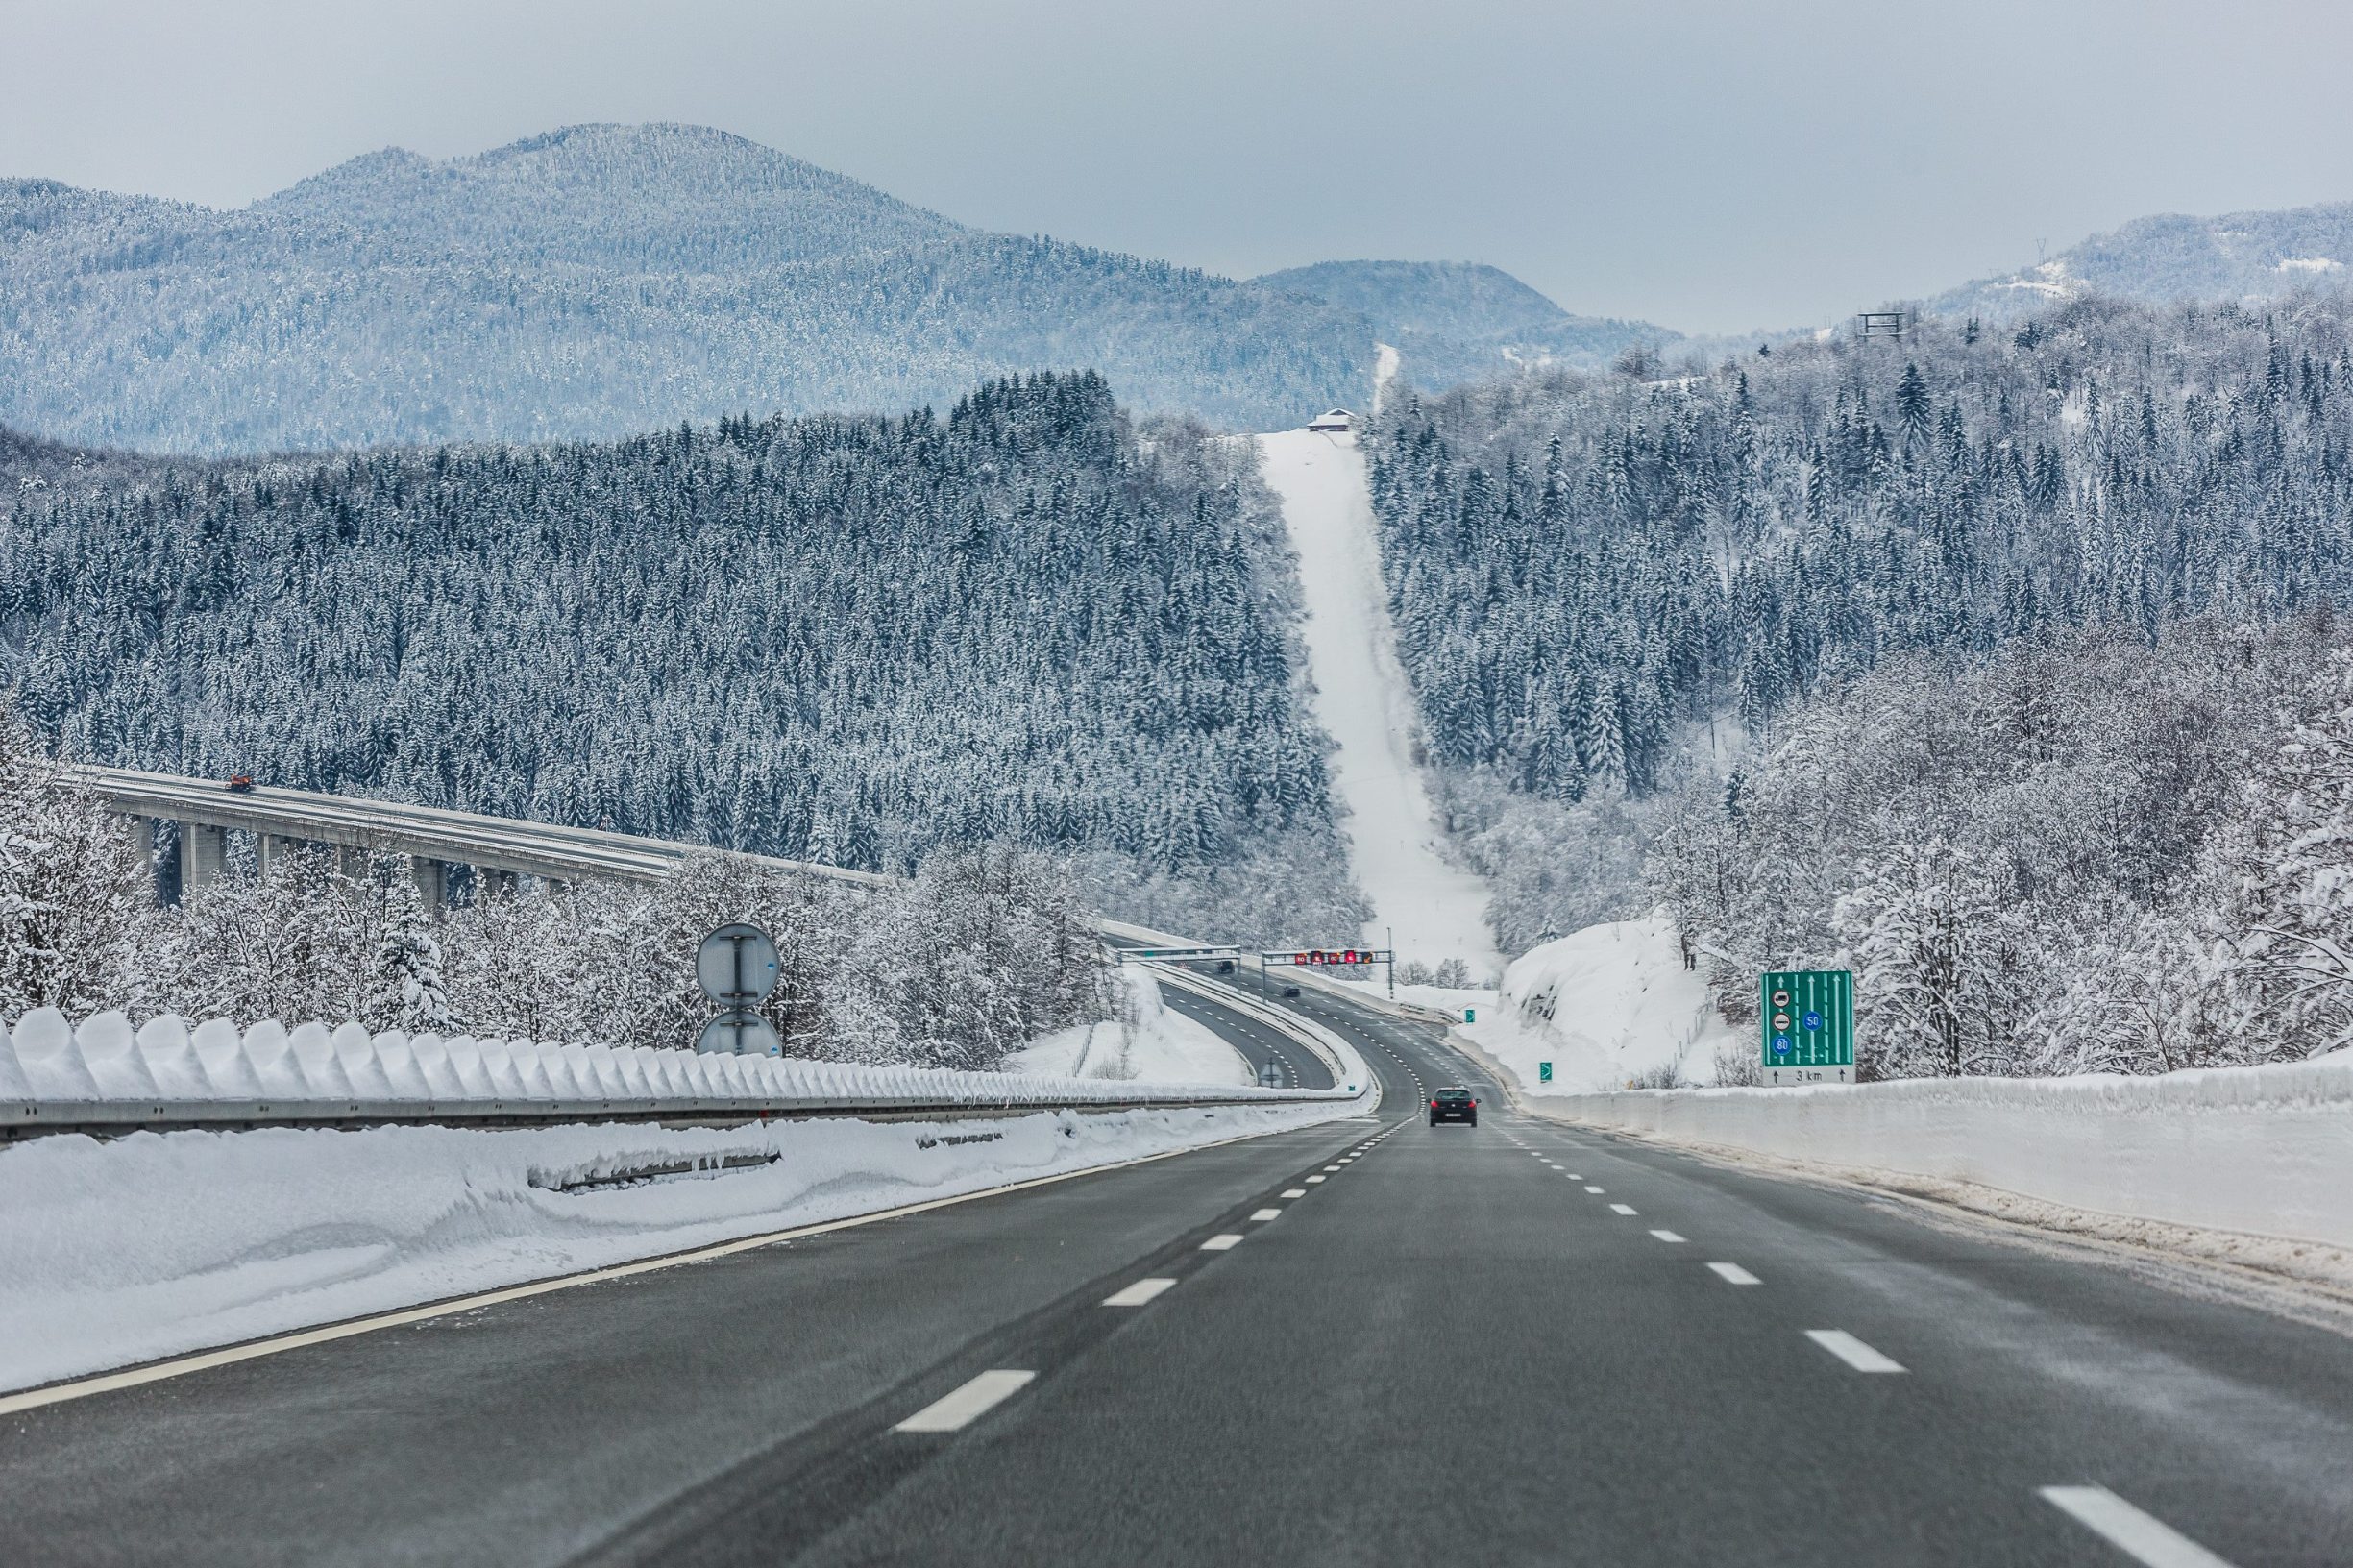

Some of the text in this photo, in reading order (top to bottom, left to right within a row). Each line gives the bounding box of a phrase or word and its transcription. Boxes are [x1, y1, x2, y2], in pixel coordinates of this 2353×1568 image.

[1807, 1017, 1818, 1025] 50
[1777, 1041, 1788, 1050] 80
[1796, 1070, 1822, 1081] 3 km
